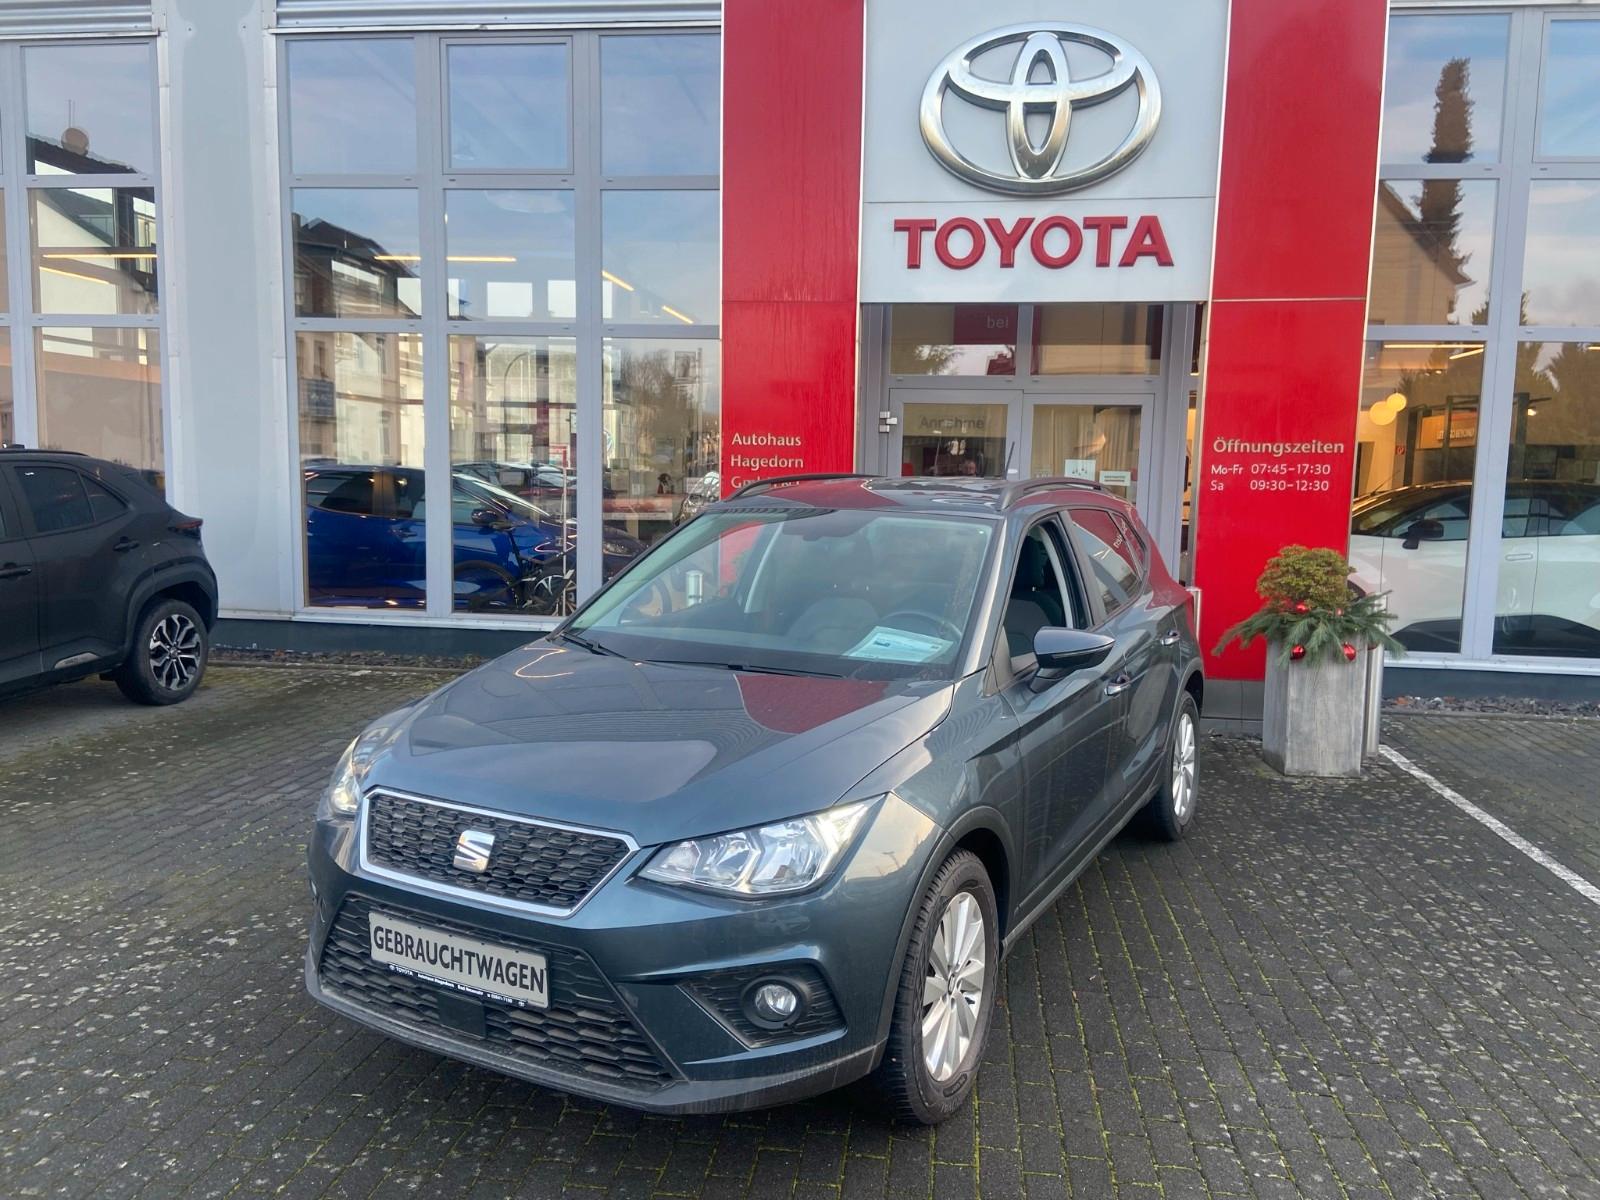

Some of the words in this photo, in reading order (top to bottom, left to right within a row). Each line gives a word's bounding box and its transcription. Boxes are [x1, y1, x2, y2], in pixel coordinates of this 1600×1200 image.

[894, 216, 1174, 269] TOYOTA
[987, 315, 1009, 329] bei
[731, 432, 802, 446] Autohaus
[1213, 437, 1345, 457] Öffnungszeiten
[730, 454, 804, 471] Hagedorn
[1211, 464, 1244, 475] Mo-Fr
[1251, 463, 1331, 475] 07:45-17:30
[1210, 480, 1224, 491] Sa
[1249, 480, 1329, 491] 09:30-12:30
[373, 926, 544, 994] GEBRAUCHTWAGEN
